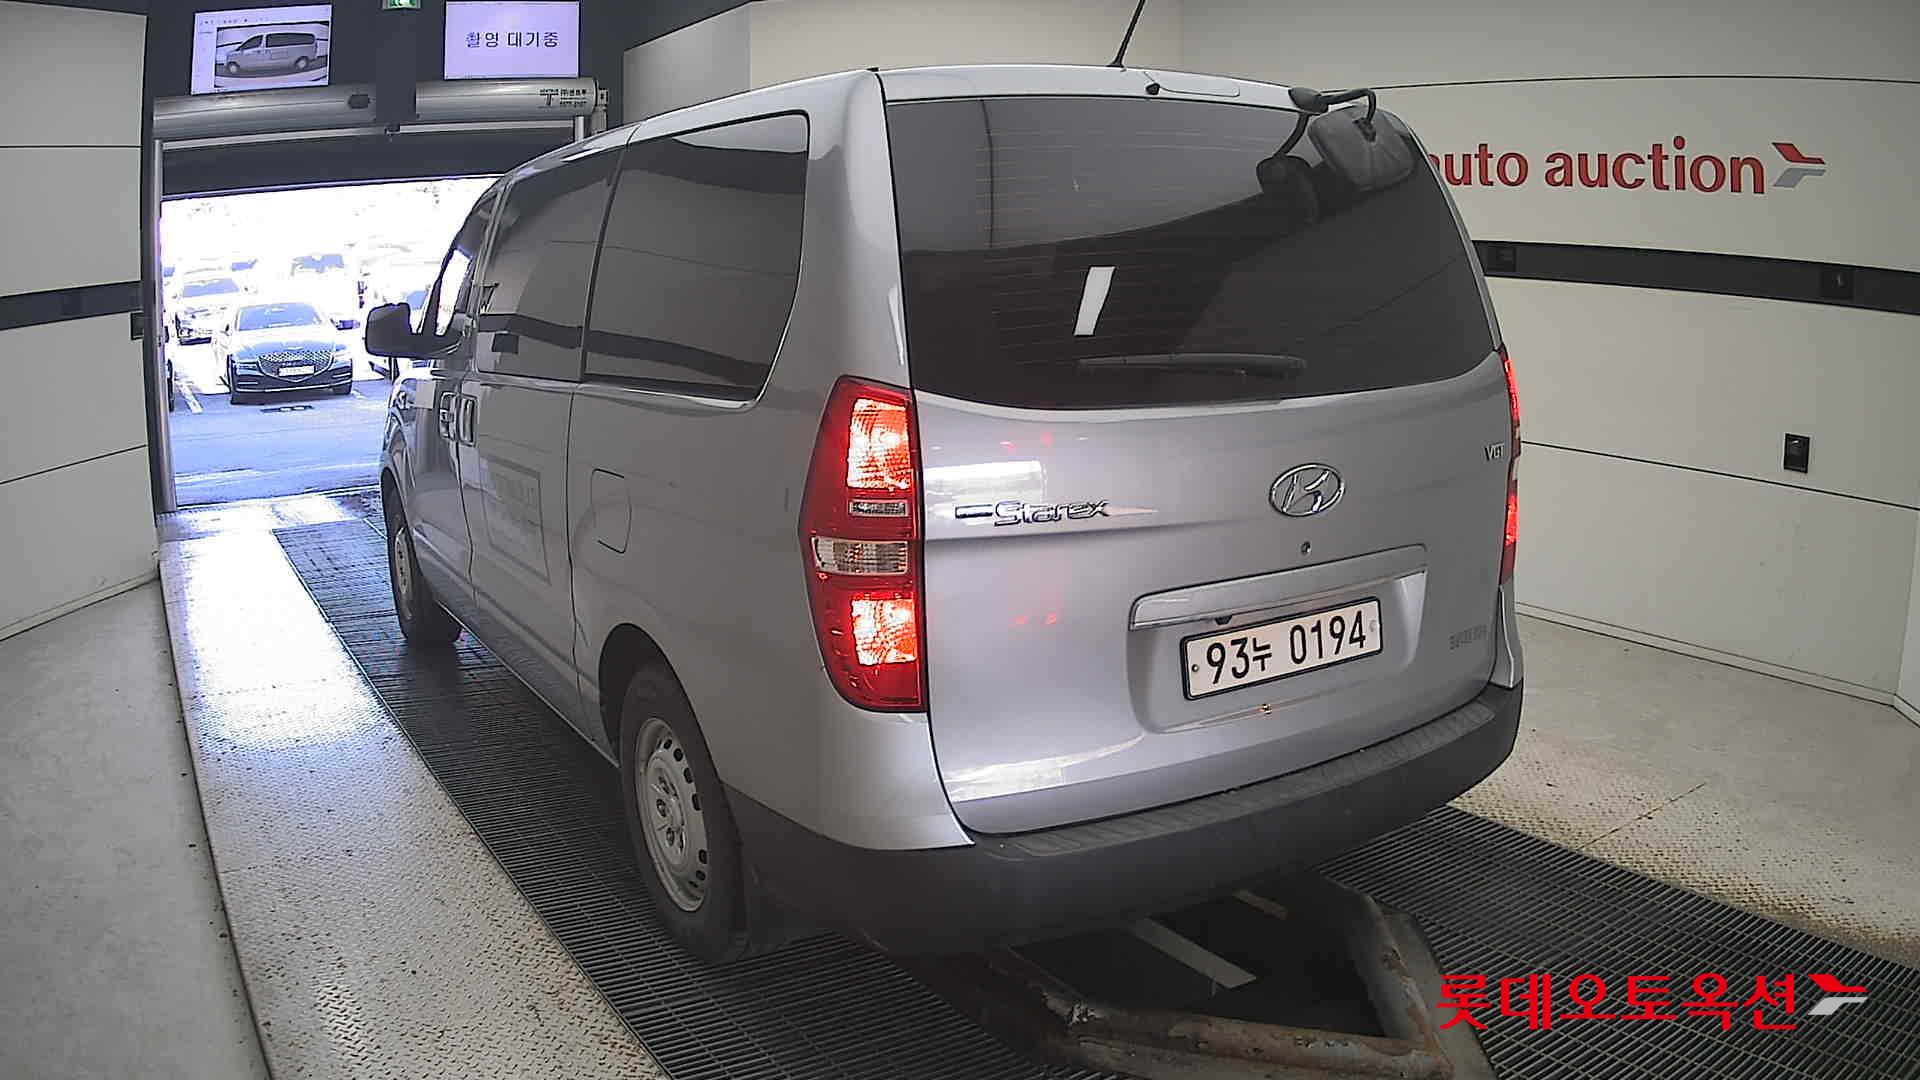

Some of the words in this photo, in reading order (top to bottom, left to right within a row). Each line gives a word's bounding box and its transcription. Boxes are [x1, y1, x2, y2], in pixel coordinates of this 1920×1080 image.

[507, 31, 559, 48] 대기중
[1543, 135, 1766, 195] auction
[994, 499, 1110, 527] Starex
[1206, 636, 1273, 685] 93누
[1289, 609, 1366, 665] 0194
